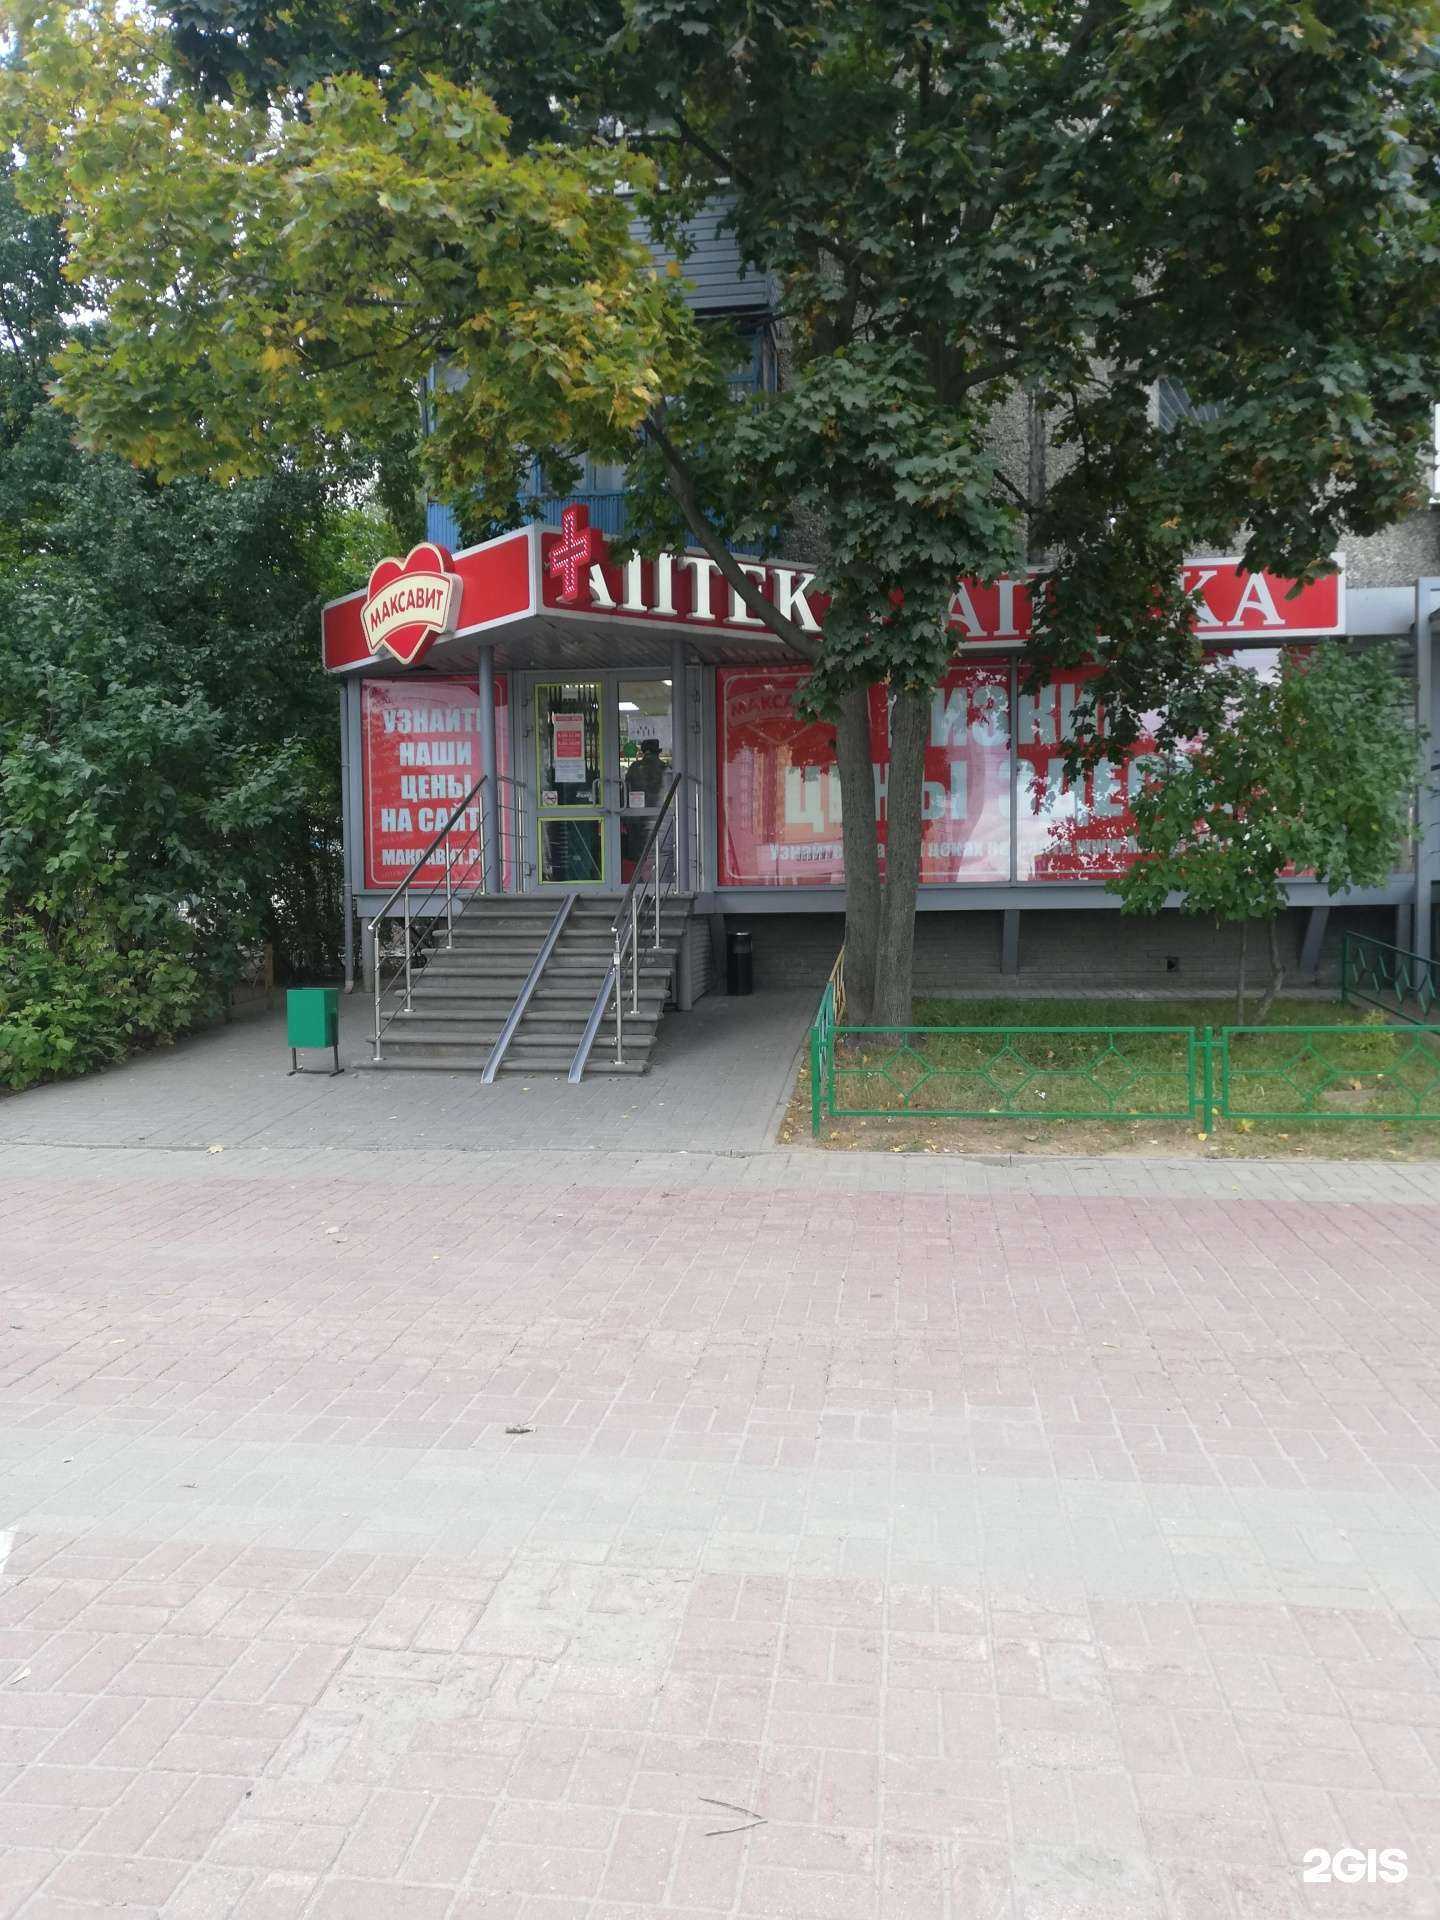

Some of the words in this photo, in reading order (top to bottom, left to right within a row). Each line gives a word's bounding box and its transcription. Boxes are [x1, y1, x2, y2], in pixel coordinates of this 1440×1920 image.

[560, 548, 823, 632] АПТЕК
[944, 570, 1286, 638] АПКА
[370, 587, 444, 632] МАКСАВИТ
[383, 703, 481, 734] УЗНАЙТ
[400, 742, 472, 766] НАШИ
[401, 774, 472, 802] ЦЕНЫ
[381, 808, 413, 833] НА
[418, 803, 481, 833] САЙТ
[382, 849, 481, 866] МАКСАВИТ.Р
